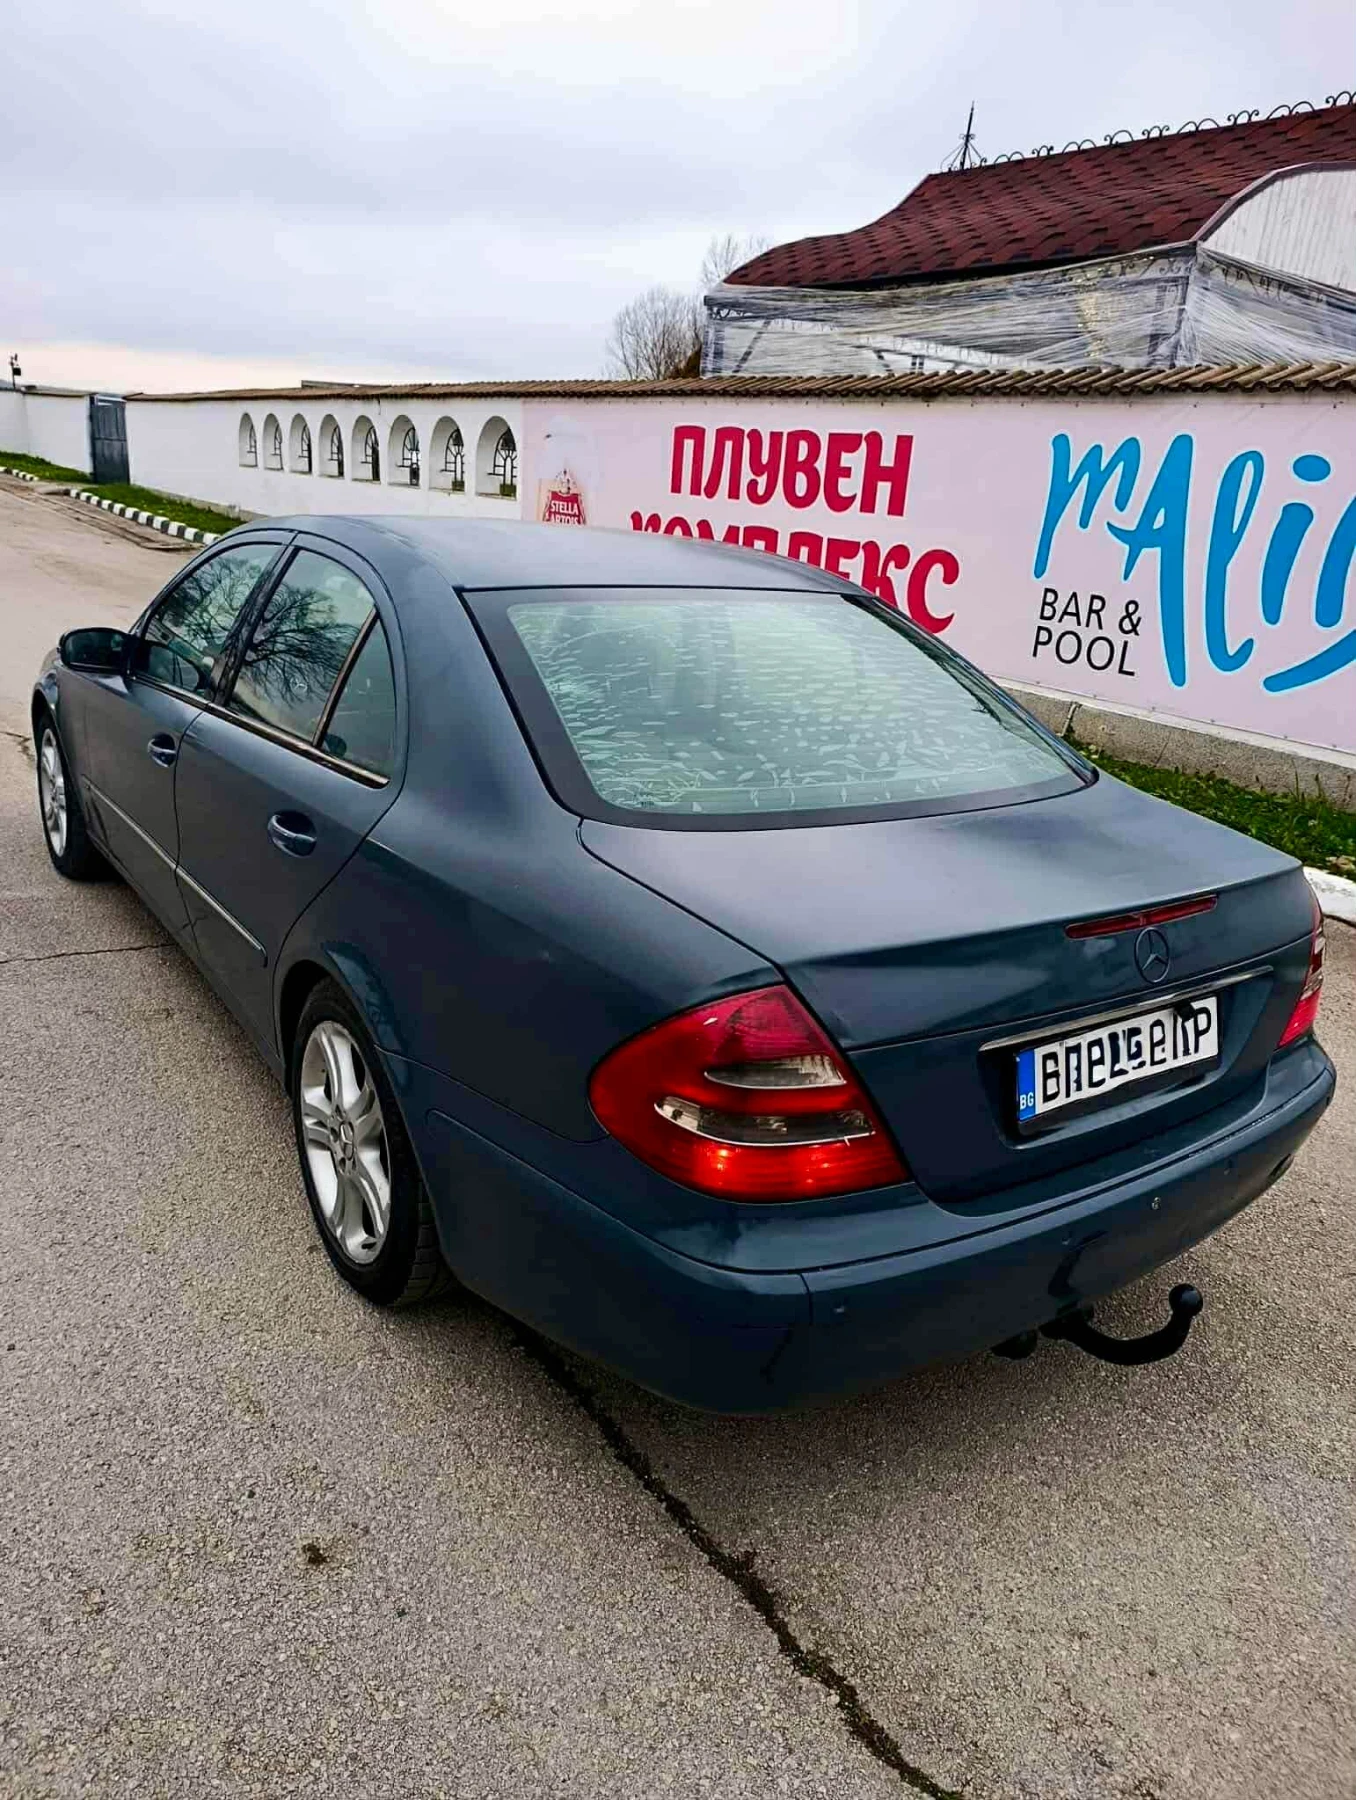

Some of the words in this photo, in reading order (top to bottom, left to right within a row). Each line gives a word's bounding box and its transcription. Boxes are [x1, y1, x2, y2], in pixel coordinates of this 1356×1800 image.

[670, 425, 914, 517] ПЛУВЕН
[550, 500, 579, 515] STELLA
[1039, 587, 1106, 630] BAR
[1118, 600, 1142, 636] &
[1032, 626, 1136, 677] POOL
[1019, 1092, 1034, 1110] BG
